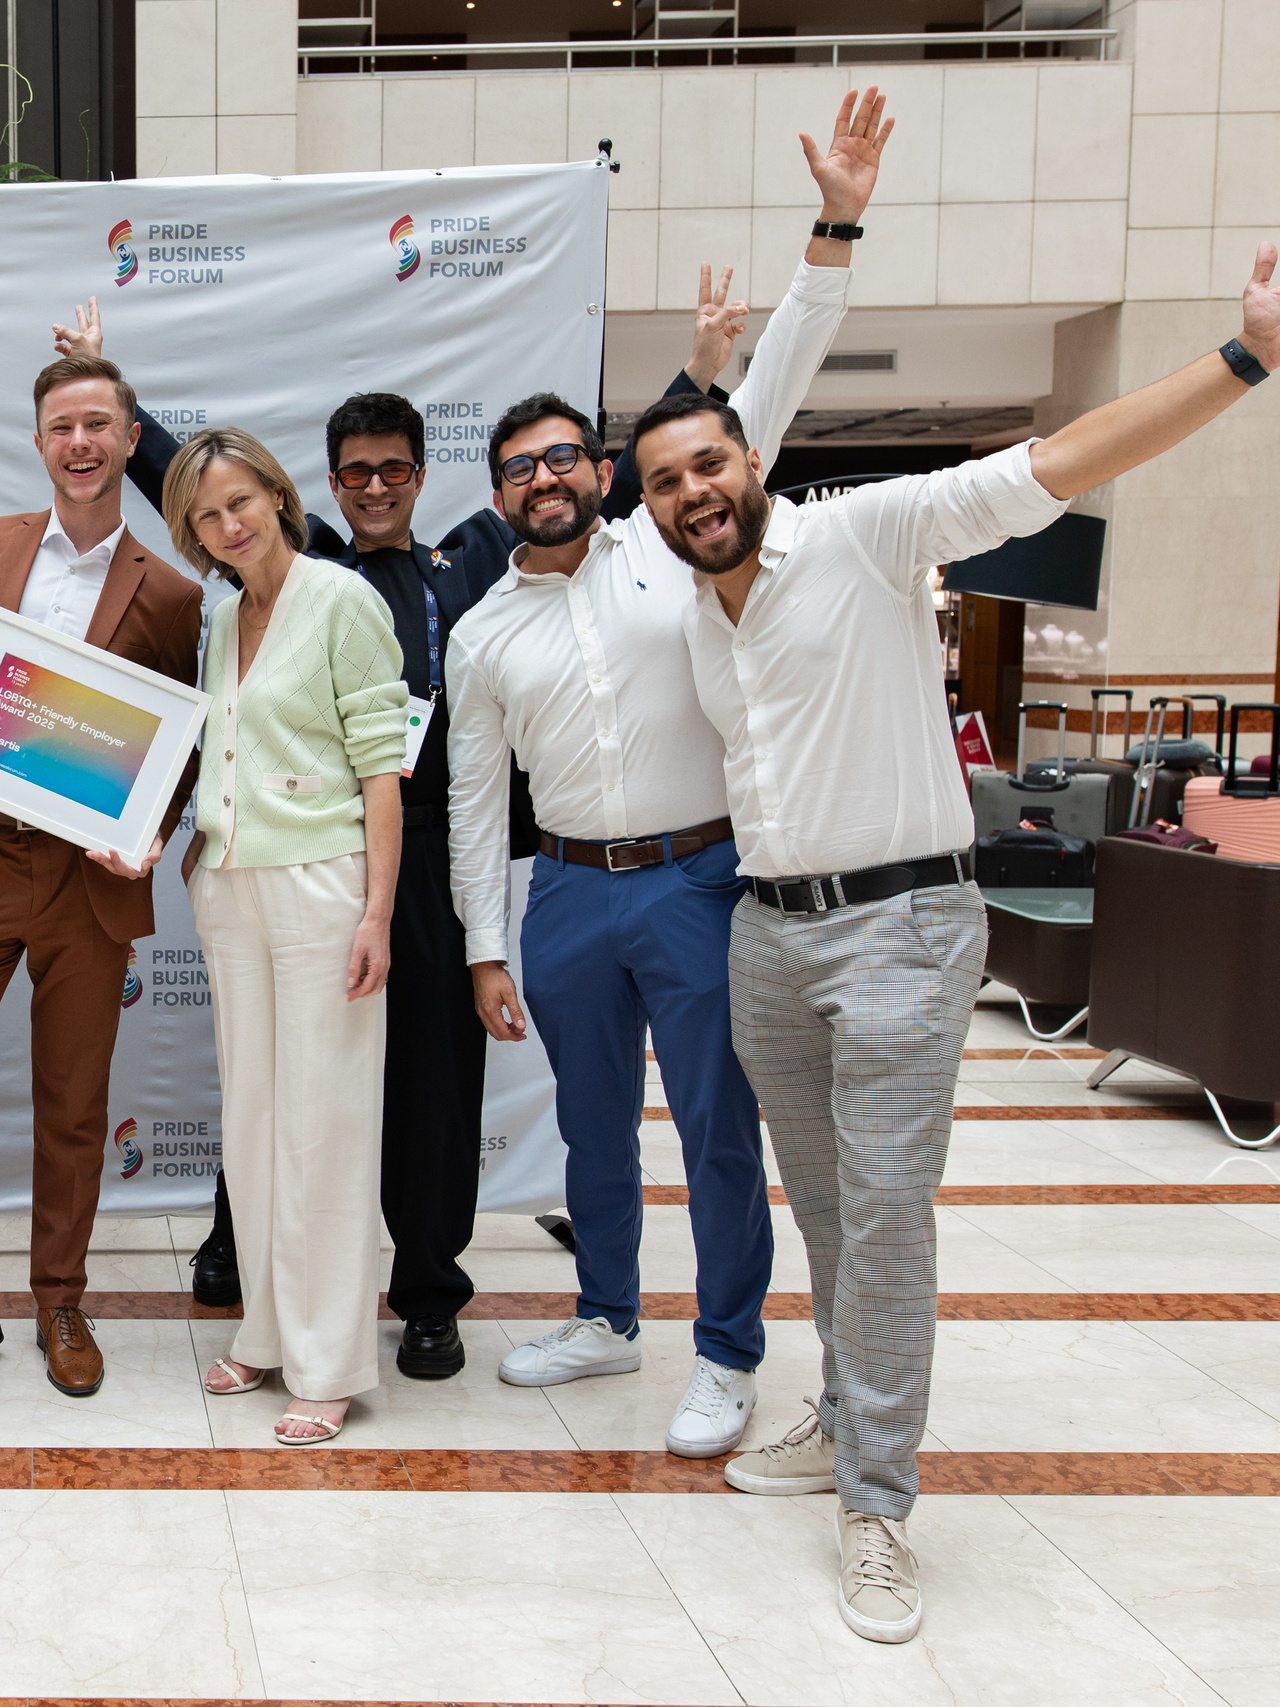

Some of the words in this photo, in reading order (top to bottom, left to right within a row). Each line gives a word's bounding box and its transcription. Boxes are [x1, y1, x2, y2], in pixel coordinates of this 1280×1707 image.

[148, 224, 208, 240] PRIDE
[430, 216, 490, 233] PRIDE
[148, 246, 246, 263] BUSINESS
[431, 237, 527, 255] BUSINESS
[148, 268, 223, 285] FORUM
[429, 261, 503, 278] FORUM
[426, 402, 483, 418] PRIDE
[425, 424, 497, 441] BUSINE
[26, 712, 56, 731] 2025
[39, 705, 79, 729] Friendly
[79, 723, 126, 749] Employer
[152, 970, 209, 985] BUSIN
[152, 991, 212, 1006] FORU
[153, 1122, 208, 1136] PRIDE
[153, 1142, 222, 1157] BUSINE
[153, 1162, 223, 1177] FORUM
